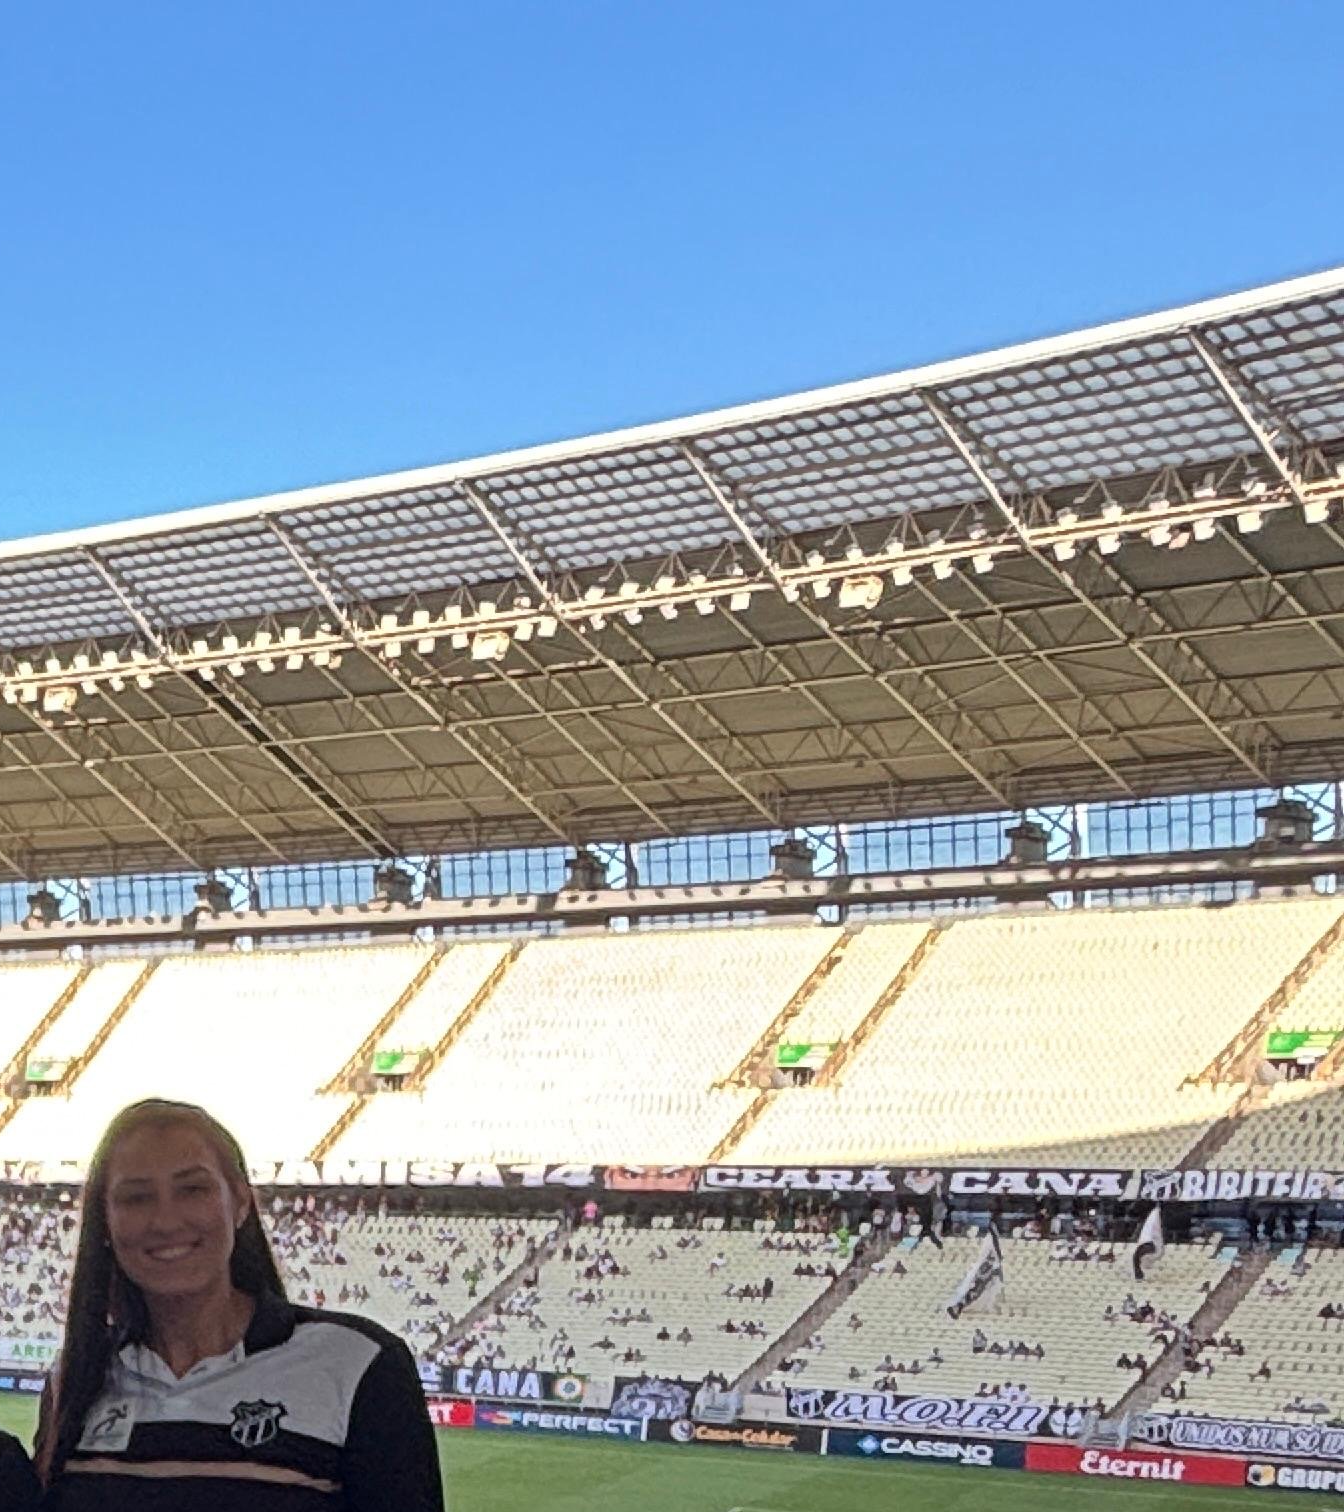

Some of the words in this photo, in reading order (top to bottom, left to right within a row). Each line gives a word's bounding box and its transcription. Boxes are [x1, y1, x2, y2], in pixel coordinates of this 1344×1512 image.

[706, 1163, 895, 1191] CEARÁ
[949, 1170, 1123, 1196] CANA
[456, 1368, 542, 1398] CANA
[521, 1411, 642, 1435] PERFECT
[880, 1437, 994, 1460] CASSINO
[1080, 1450, 1186, 1480] Eternit
